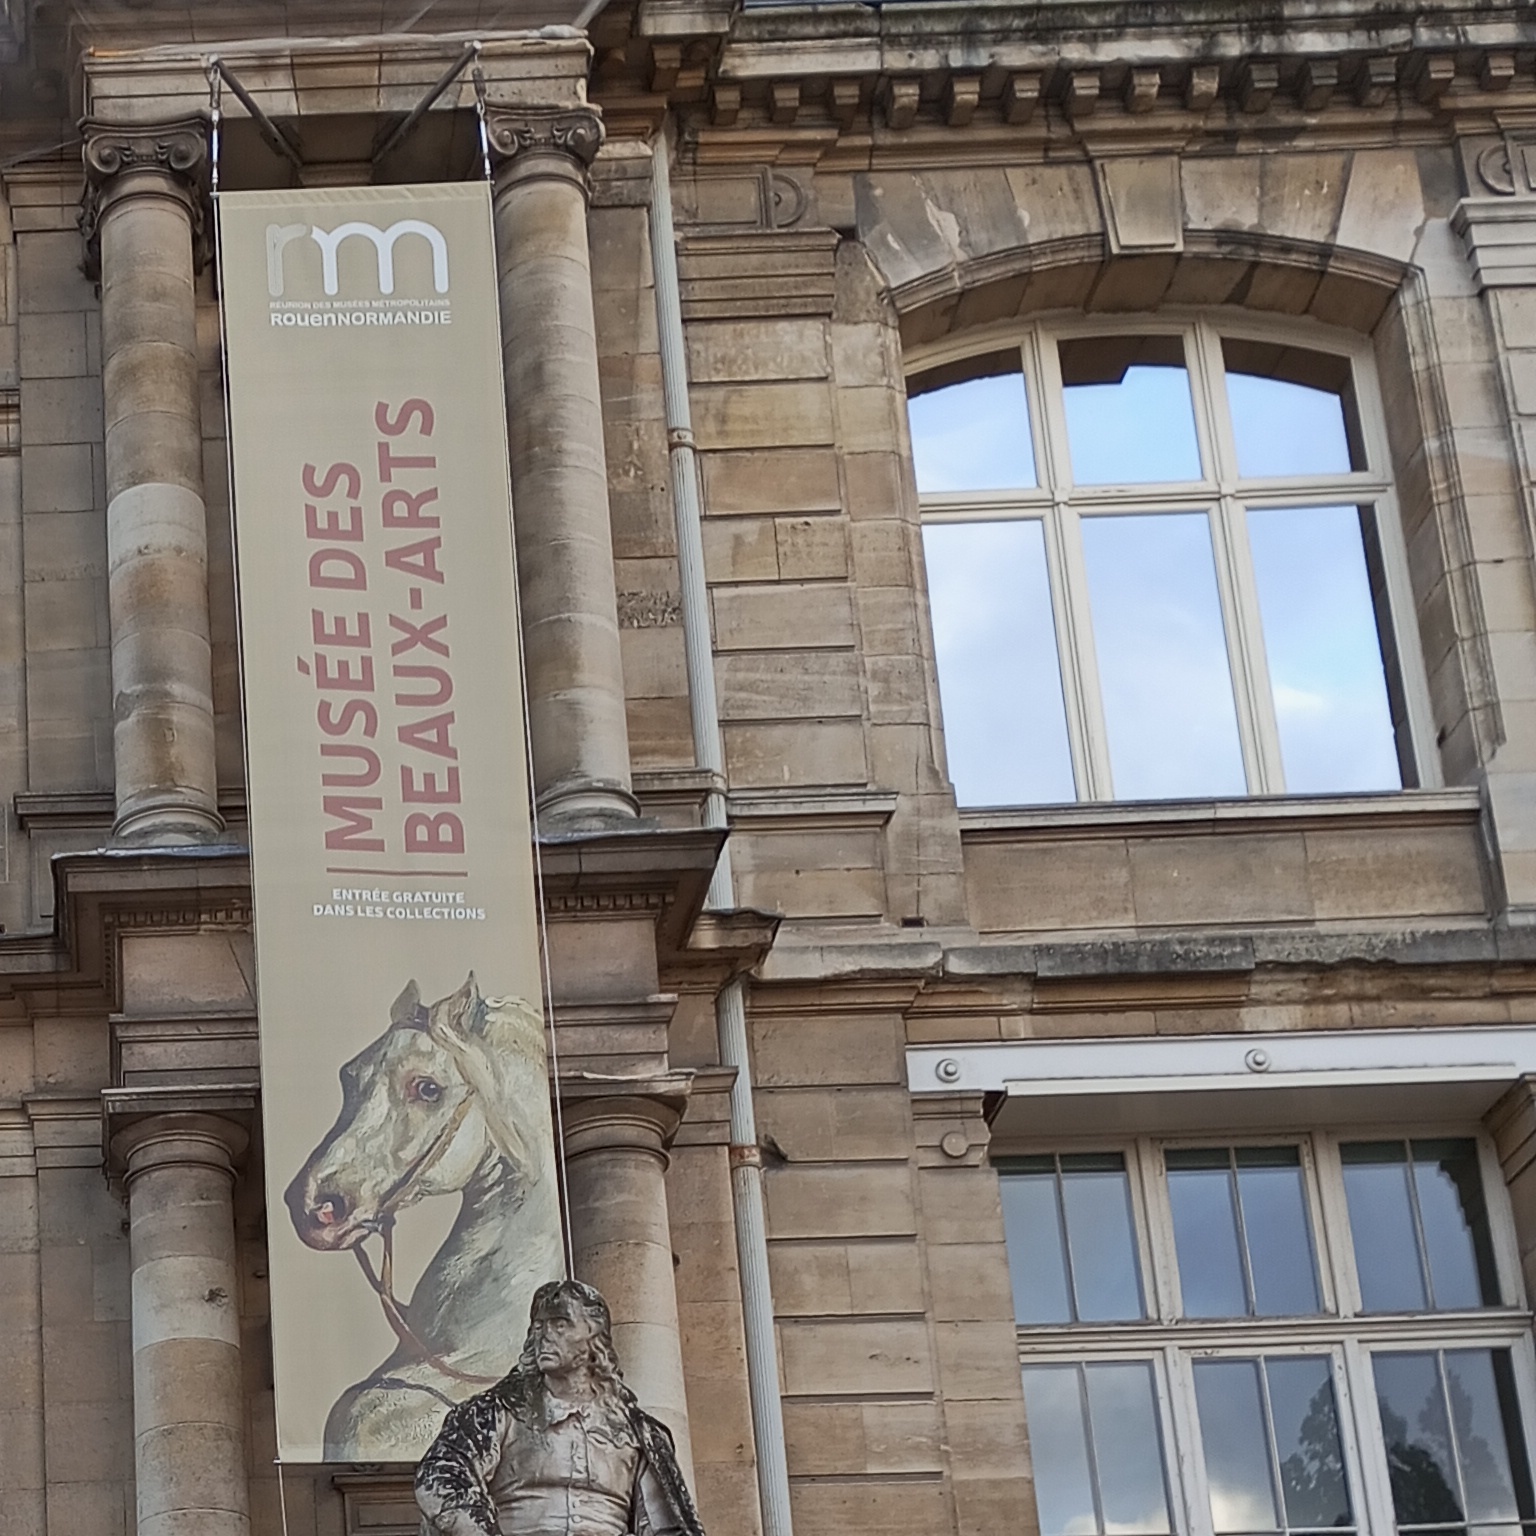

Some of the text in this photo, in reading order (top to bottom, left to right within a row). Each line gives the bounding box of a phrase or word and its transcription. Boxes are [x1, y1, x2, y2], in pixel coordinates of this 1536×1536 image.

[269, 298, 450, 309] RÉUNION DES MUSÉES MÉTROPOLITAINS
[374, 397, 466, 855] BEAUX-ARTS
[297, 461, 386, 853] MUSÉE DES
[332, 886, 465, 905] ENTRÉE GRATUITE
[313, 903, 486, 920] DANS LES COLLECTIONS
